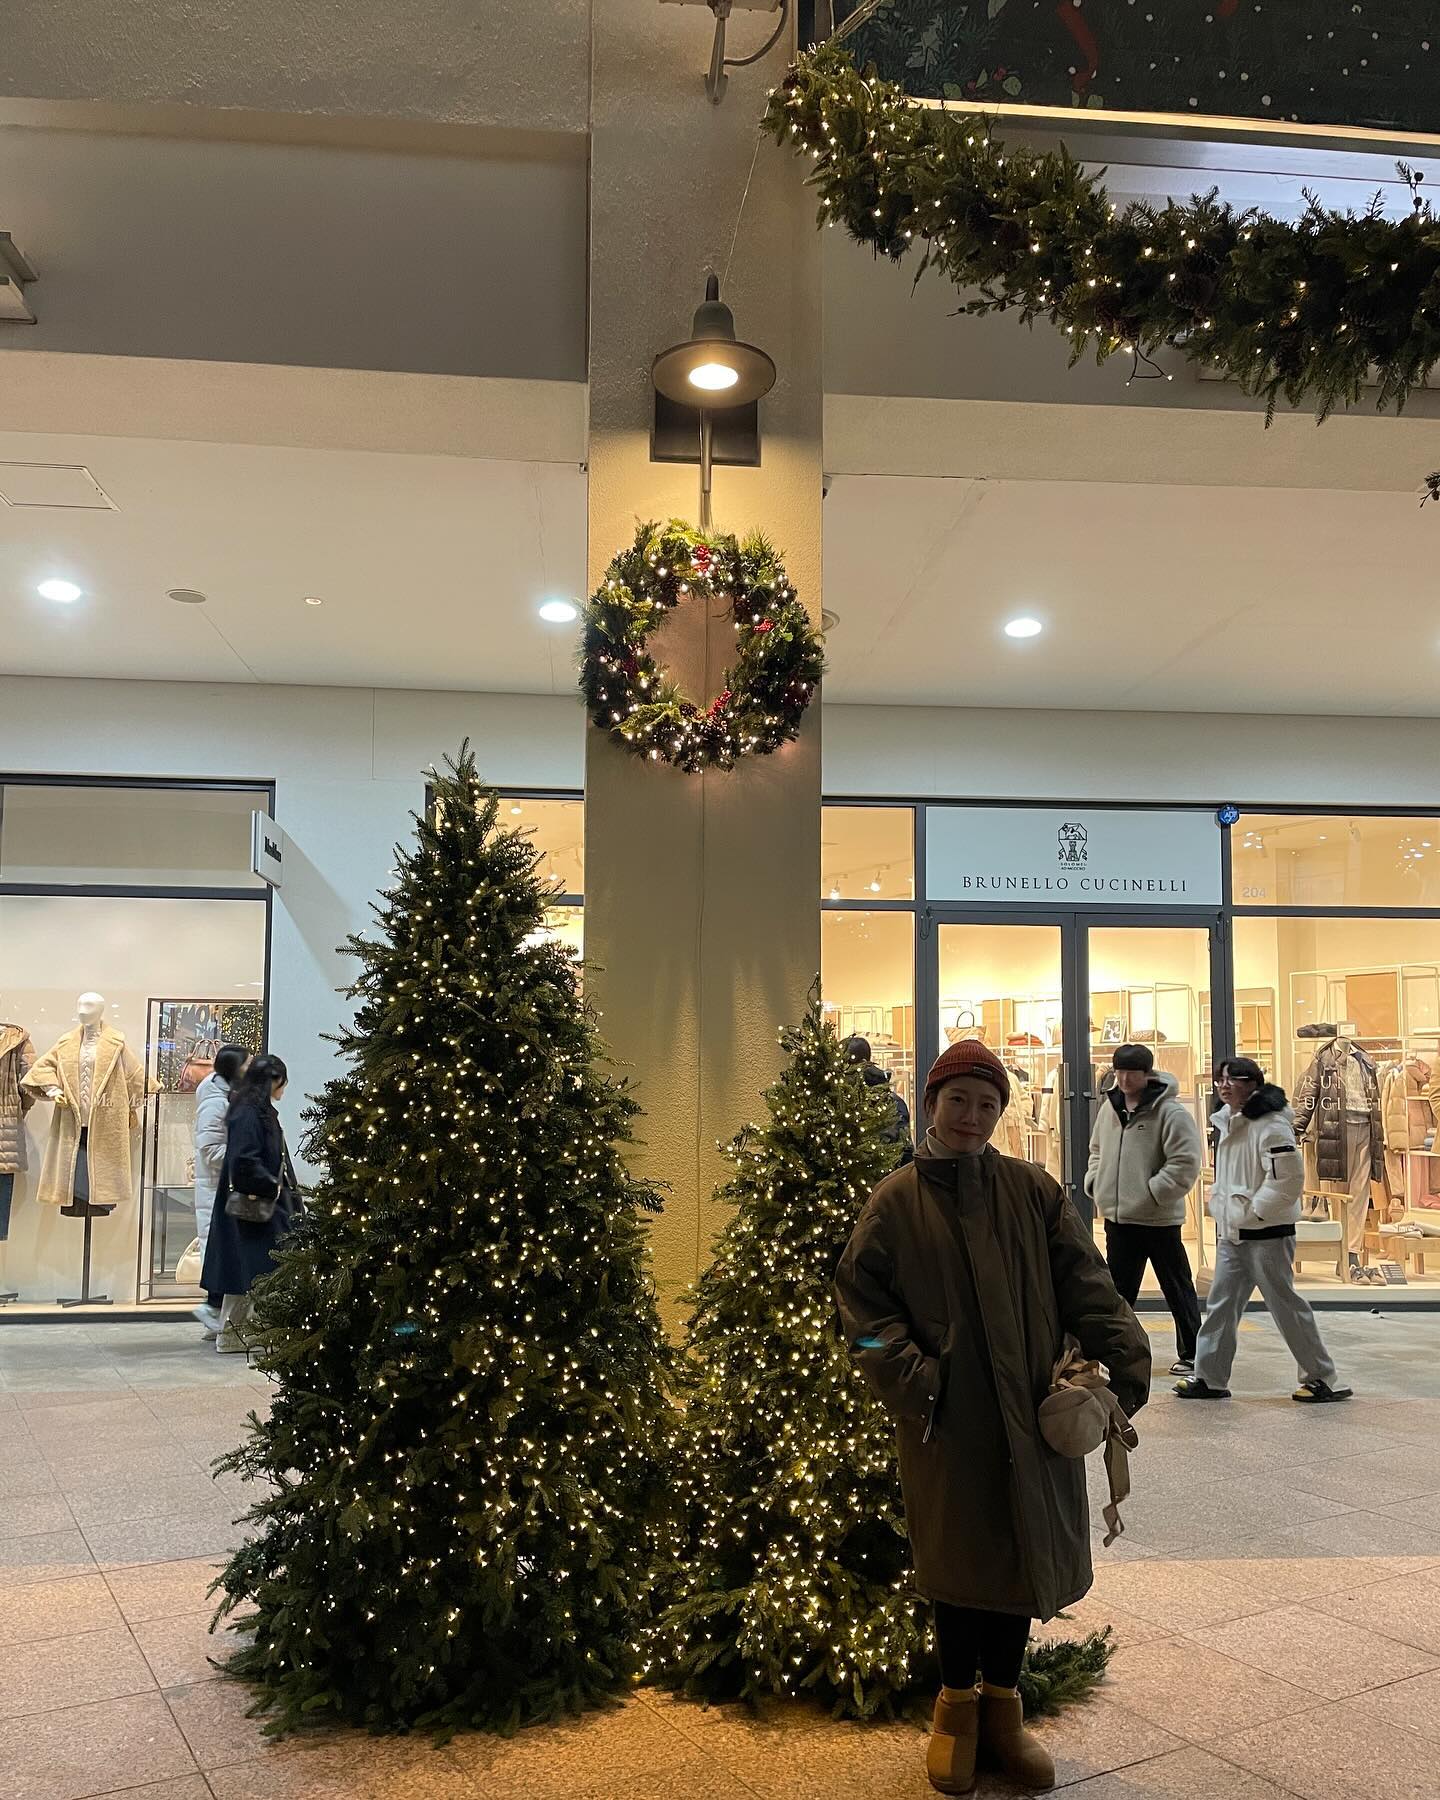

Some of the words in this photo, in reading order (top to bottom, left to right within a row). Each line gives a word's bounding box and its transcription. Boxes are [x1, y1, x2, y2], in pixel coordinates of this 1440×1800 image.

[962, 876, 1069, 890] BRUNELLO
[1080, 878, 1187, 892] CUCINELLI
[1242, 887, 1265, 898] 204
